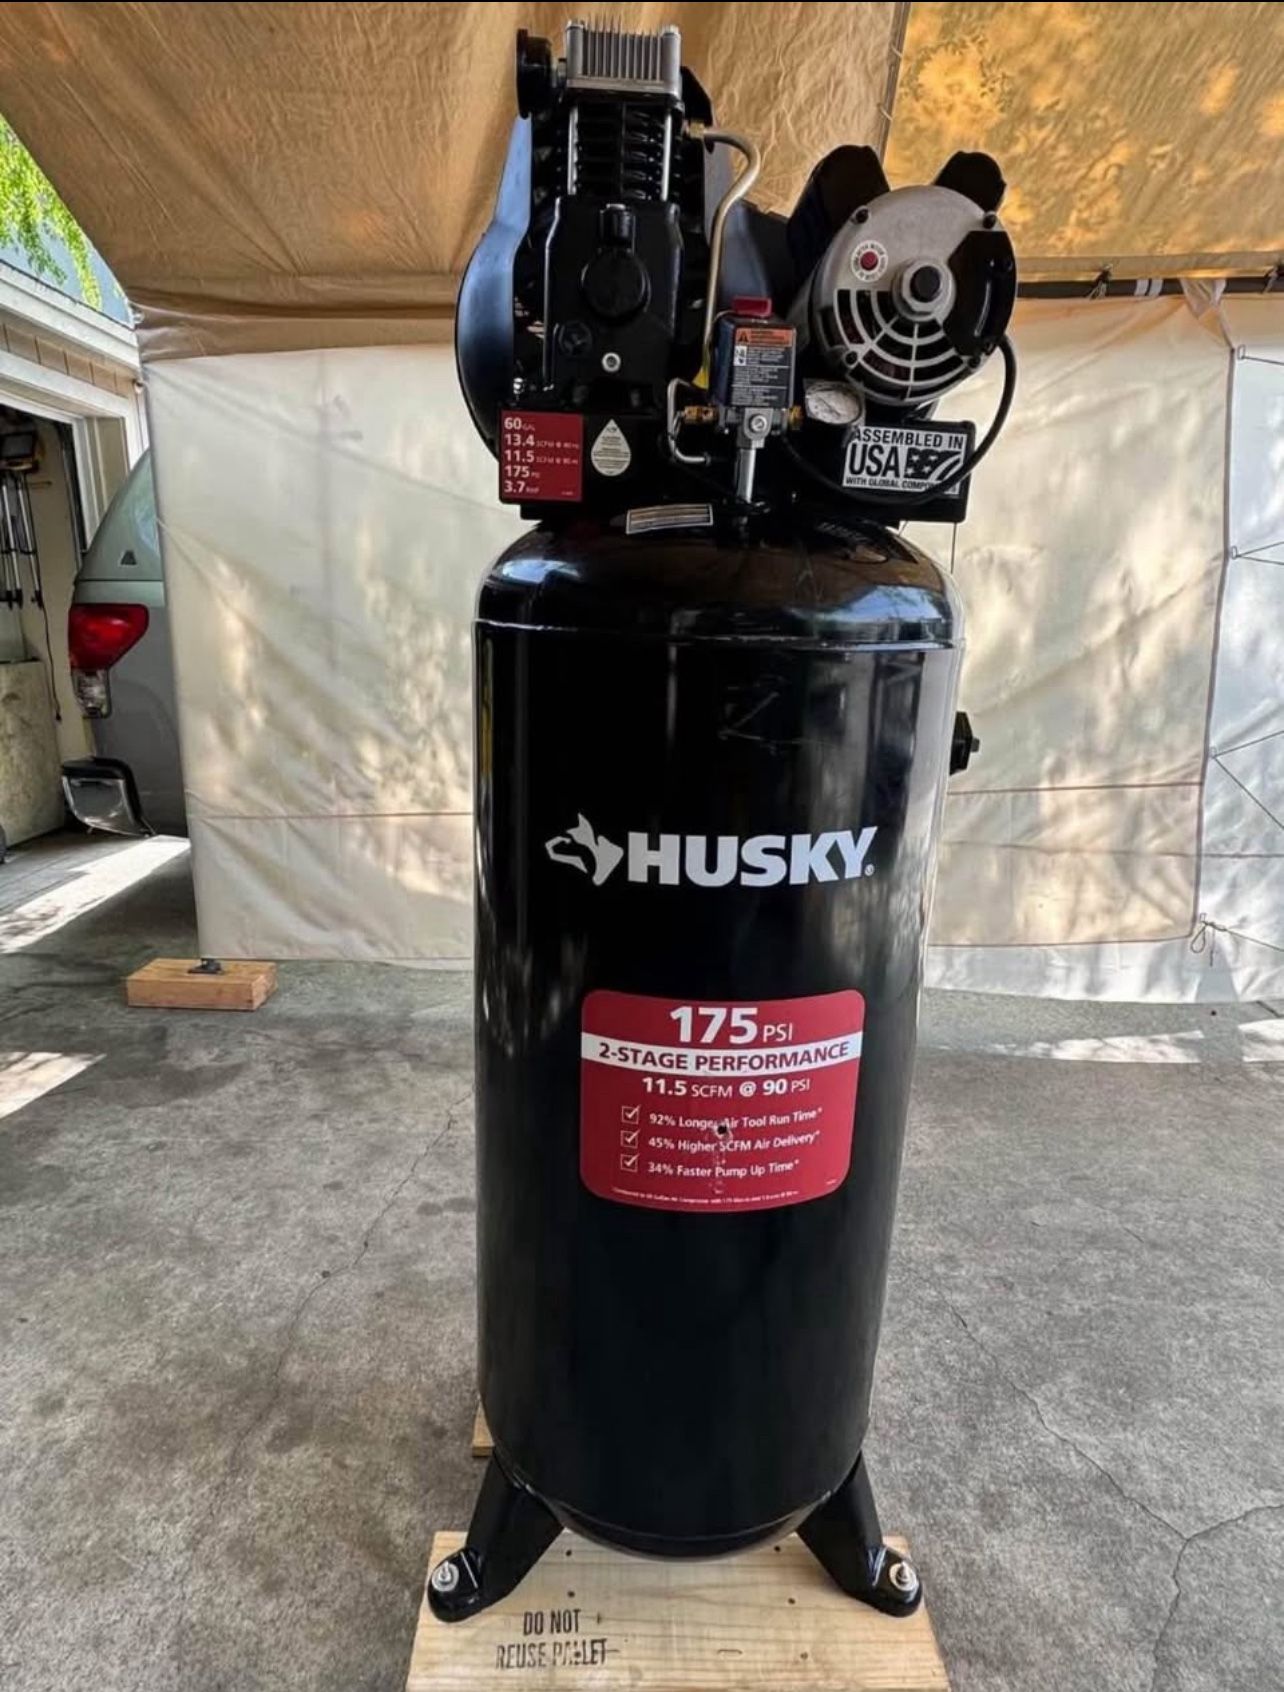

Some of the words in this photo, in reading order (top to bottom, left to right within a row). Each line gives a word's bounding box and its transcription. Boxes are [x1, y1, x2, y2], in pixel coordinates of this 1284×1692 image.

[504, 417, 522, 430] 60
[504, 433, 535, 447] 13.4
[853, 428, 943, 447] ASSEMBLED
[948, 435, 964, 449] IN
[504, 450, 535, 463] 11.5
[849, 443, 900, 478] USA
[504, 465, 530, 478] 175
[846, 476, 866, 485] WITH
[504, 481, 526, 493] 3.7
[628, 826, 878, 887] HUSKY
[670, 1005, 758, 1044] 175
[763, 1023, 794, 1043] PSI
[599, 1042, 688, 1070] 2-STAGE
[695, 1041, 849, 1072] PERFORMANCE
[642, 1077, 688, 1096] 11.5
[691, 1084, 733, 1098] SCFM
[739, 1080, 757, 1097] @
[763, 1078, 788, 1096] 90
[791, 1079, 810, 1093] PSI
[649, 1113, 676, 1126] 92%
[720, 1117, 739, 1129] Air
[741, 1115, 767, 1128] Tool
[769, 1114, 790, 1126] Run
[648, 1137, 675, 1150] 45%
[678, 1140, 717, 1154] Higher
[719, 1140, 752, 1152] SCFM
[753, 1139, 770, 1150] Air
[648, 1161, 674, 1175] 34%
[677, 1165, 712, 1177] Faster
[715, 1166, 748, 1179] Pump
[750, 1164, 766, 1177] Up
[523, 1611, 544, 1636] DO
[550, 1608, 581, 1635] NOT
[496, 1642, 547, 1670] REUSE
